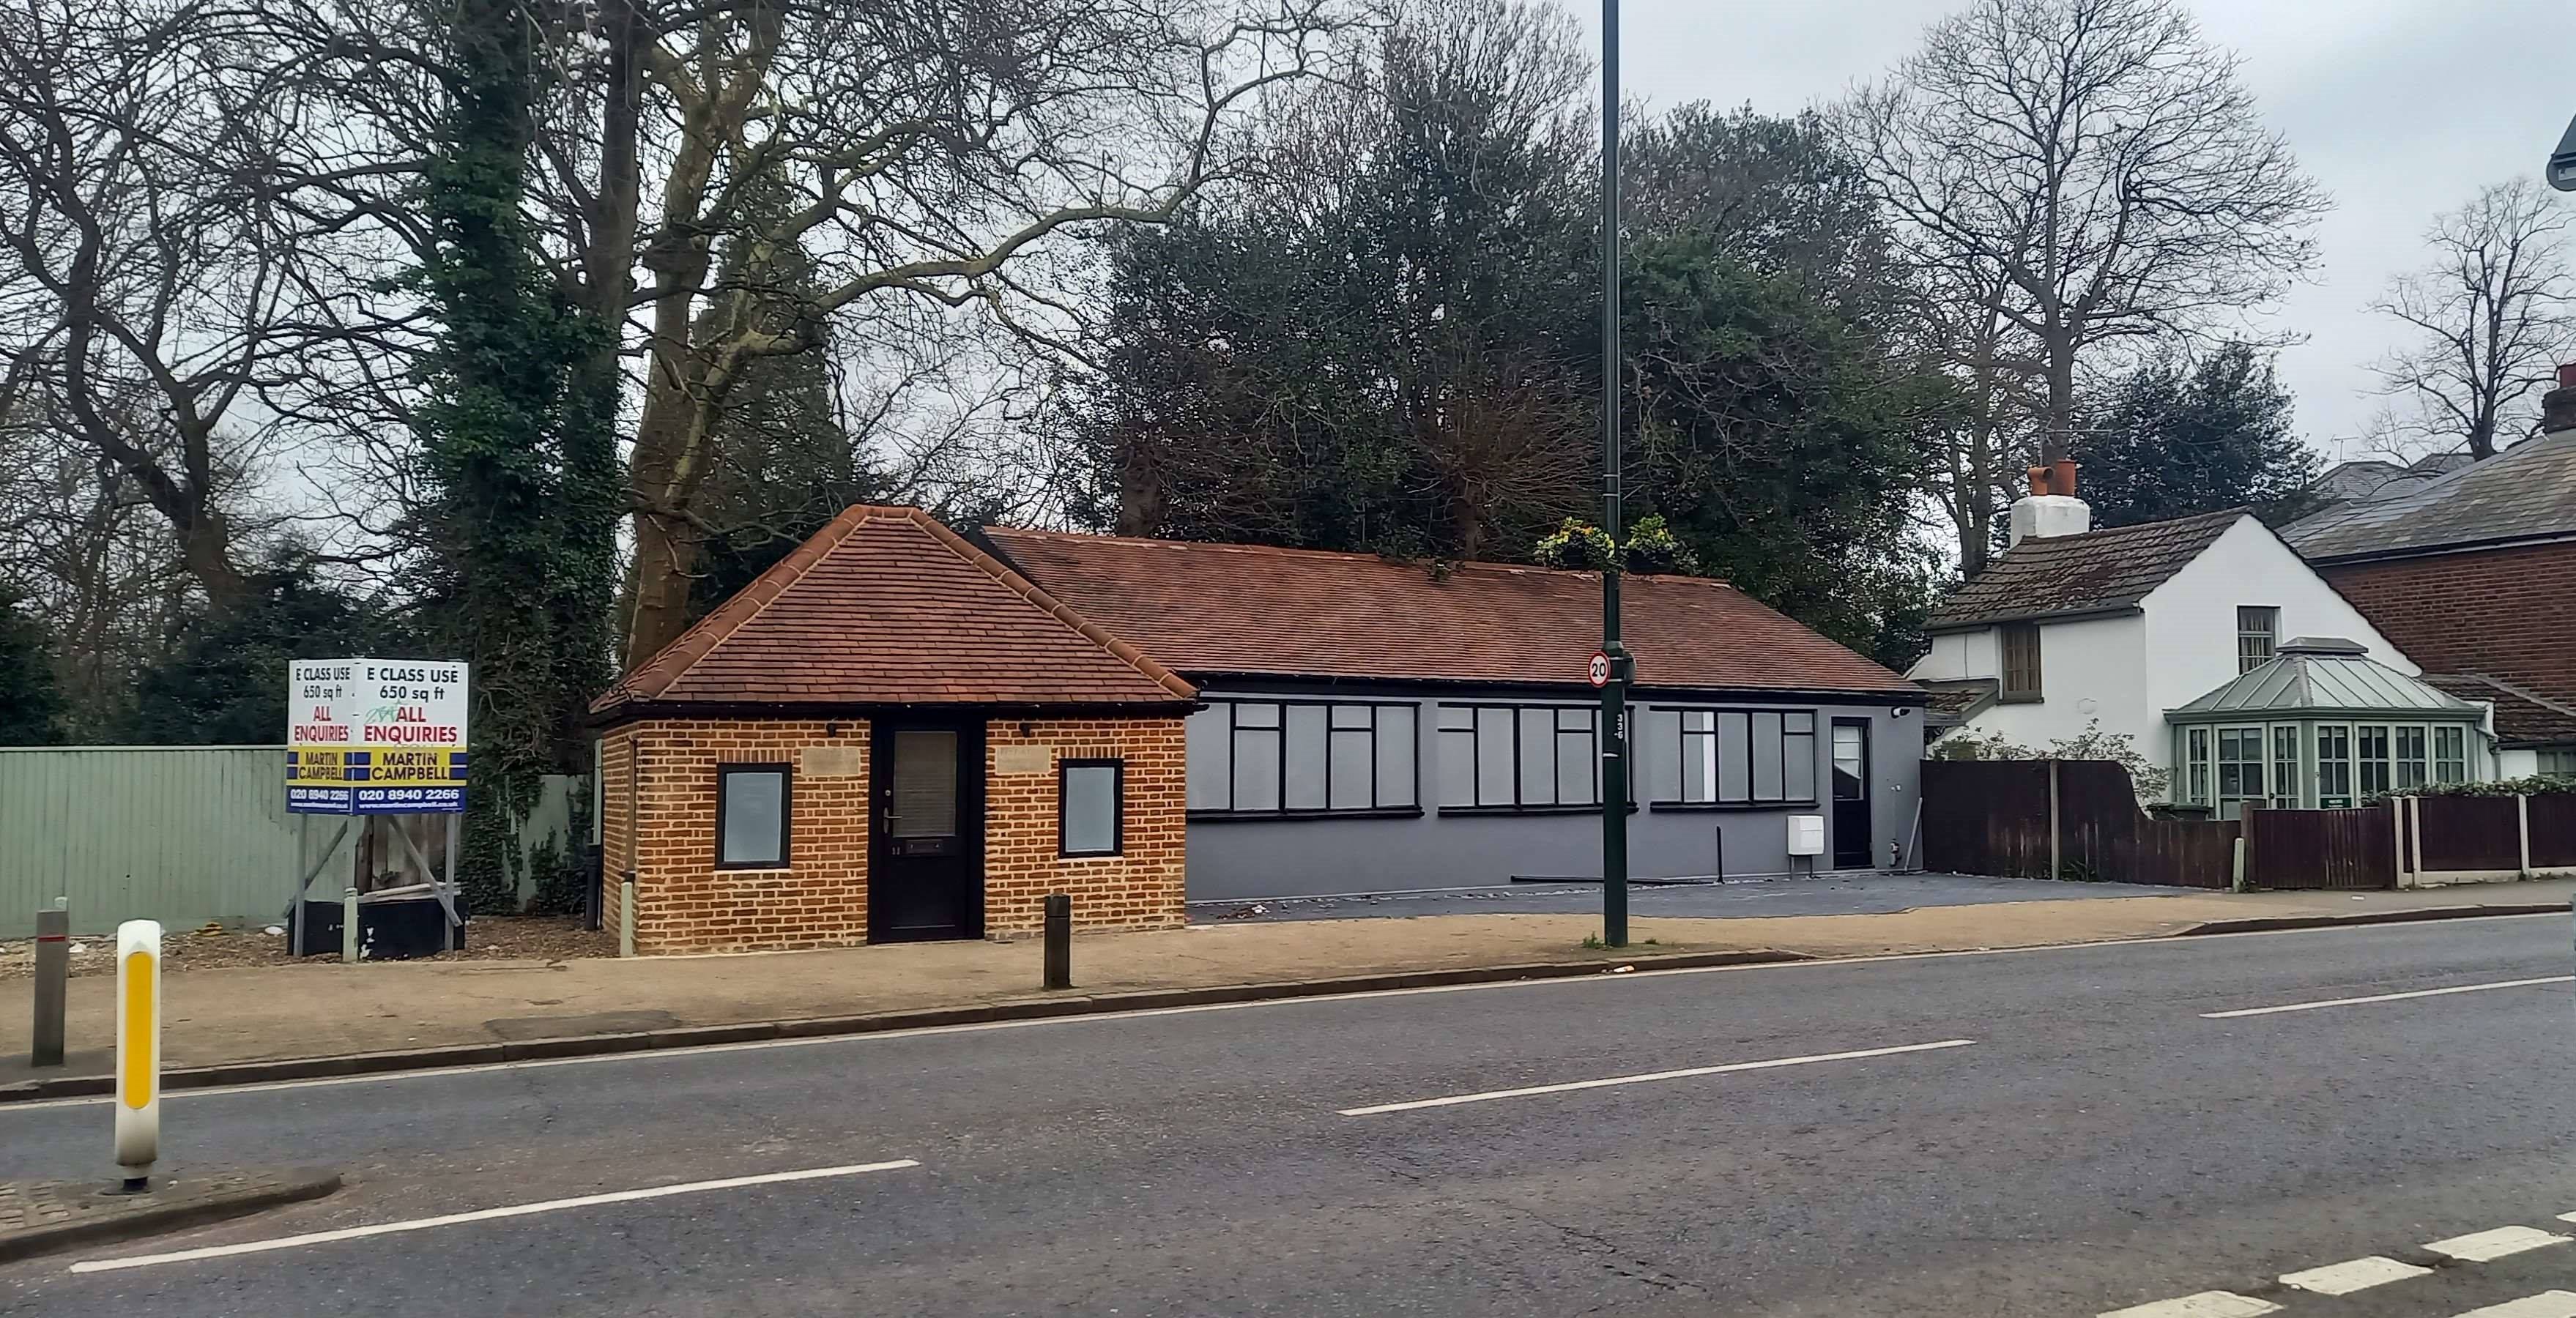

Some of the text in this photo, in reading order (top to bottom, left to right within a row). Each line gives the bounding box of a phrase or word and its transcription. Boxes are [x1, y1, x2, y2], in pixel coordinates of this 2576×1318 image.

[296, 667, 350, 681] E CLASS USE
[367, 667, 459, 682] E CLASS USE
[1592, 663, 1606, 677] 20
[303, 684, 342, 701] 650 sq ft
[380, 685, 445, 703] 650 sq ft
[313, 706, 331, 721] ALL
[396, 707, 426, 722] ALL
[294, 725, 349, 742] ENQUIRIES
[364, 726, 457, 744] ENQUIRIES
[305, 752, 338, 765] MARTIN
[383, 753, 437, 765] MARTIN
[299, 767, 342, 780] CAMPBELL
[371, 767, 448, 780] CAMPBELL
[290, 789, 307, 799] 020
[358, 789, 459, 800] 020 8940 2266
